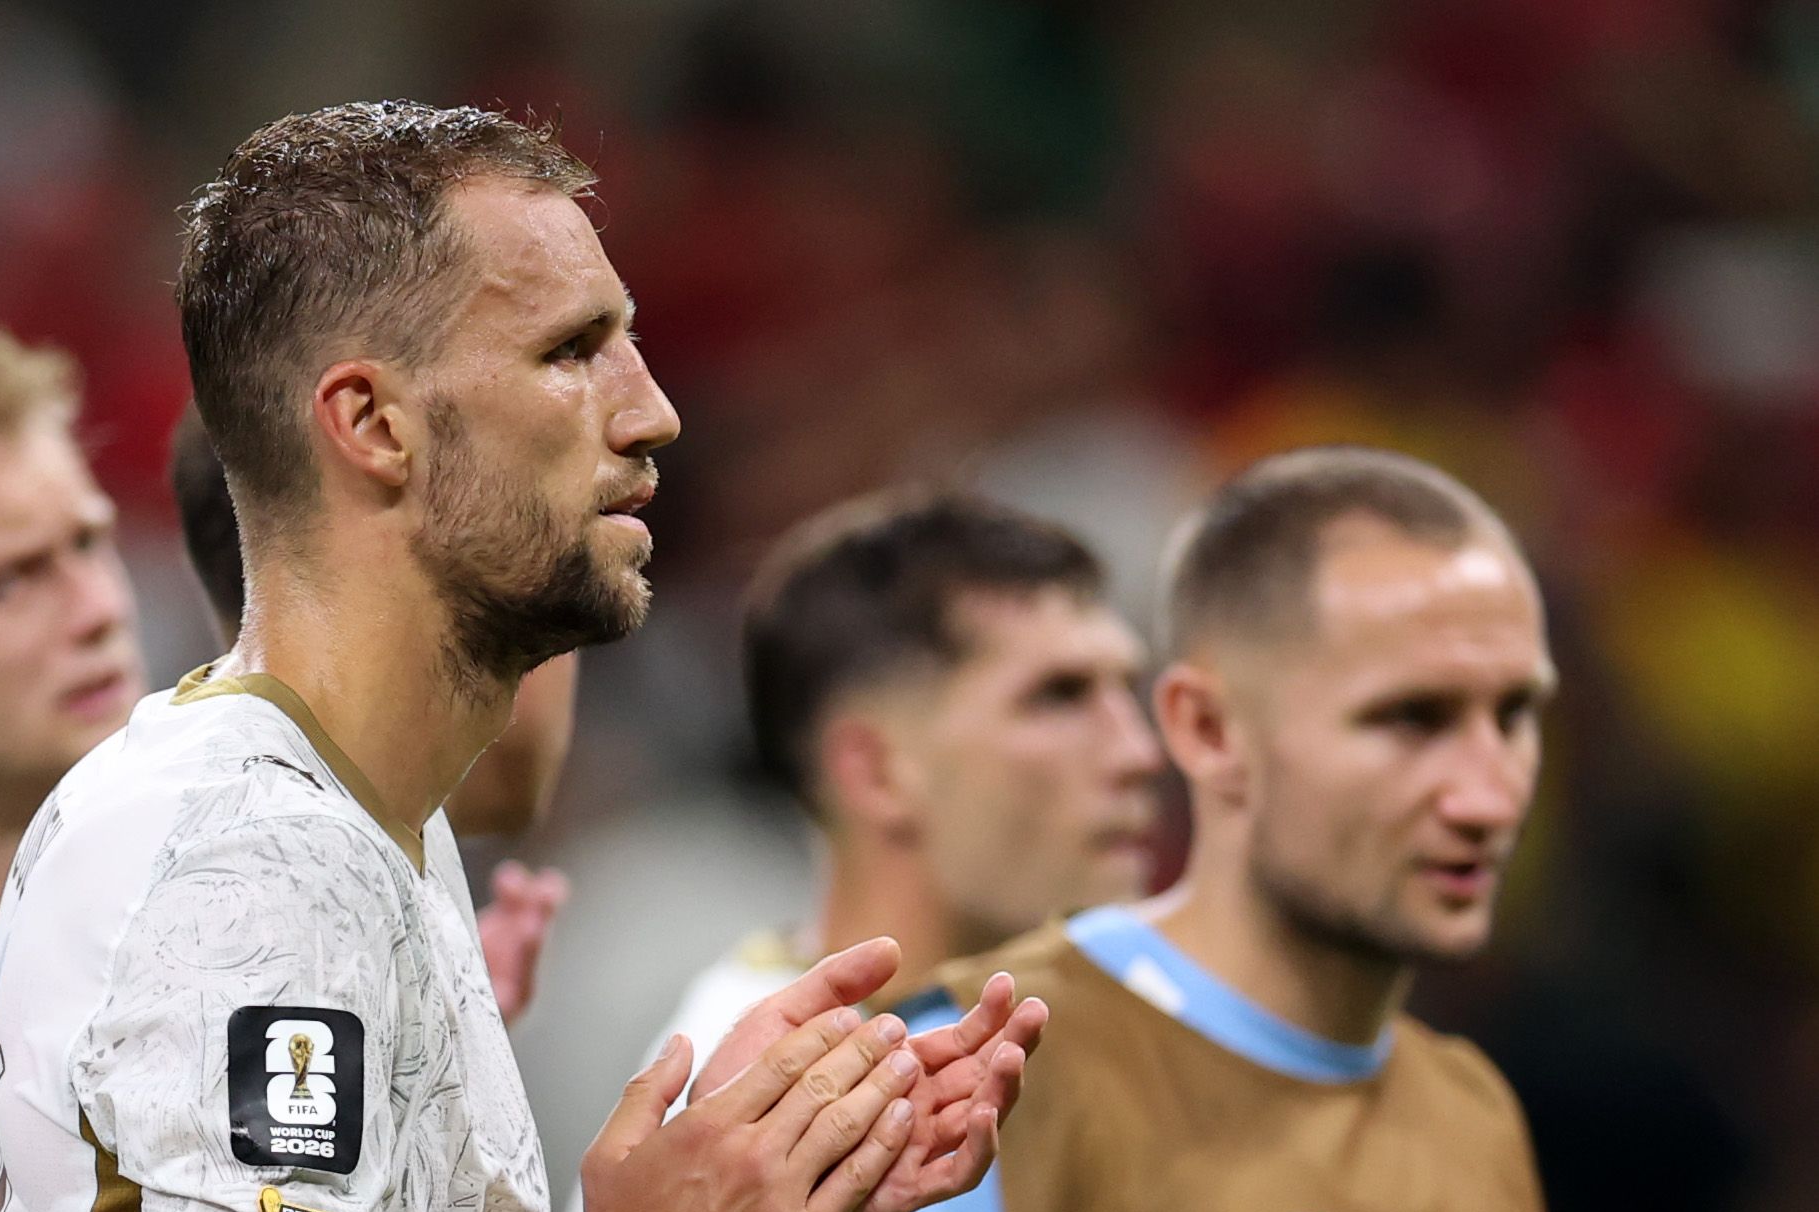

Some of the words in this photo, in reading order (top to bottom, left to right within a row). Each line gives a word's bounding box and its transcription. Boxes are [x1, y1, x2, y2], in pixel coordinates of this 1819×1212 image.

[288, 1105, 318, 1114] FIFA
[270, 1127, 313, 1139] WORLD
[314, 1128, 336, 1140] CUP
[270, 1138, 335, 1158] 2026
